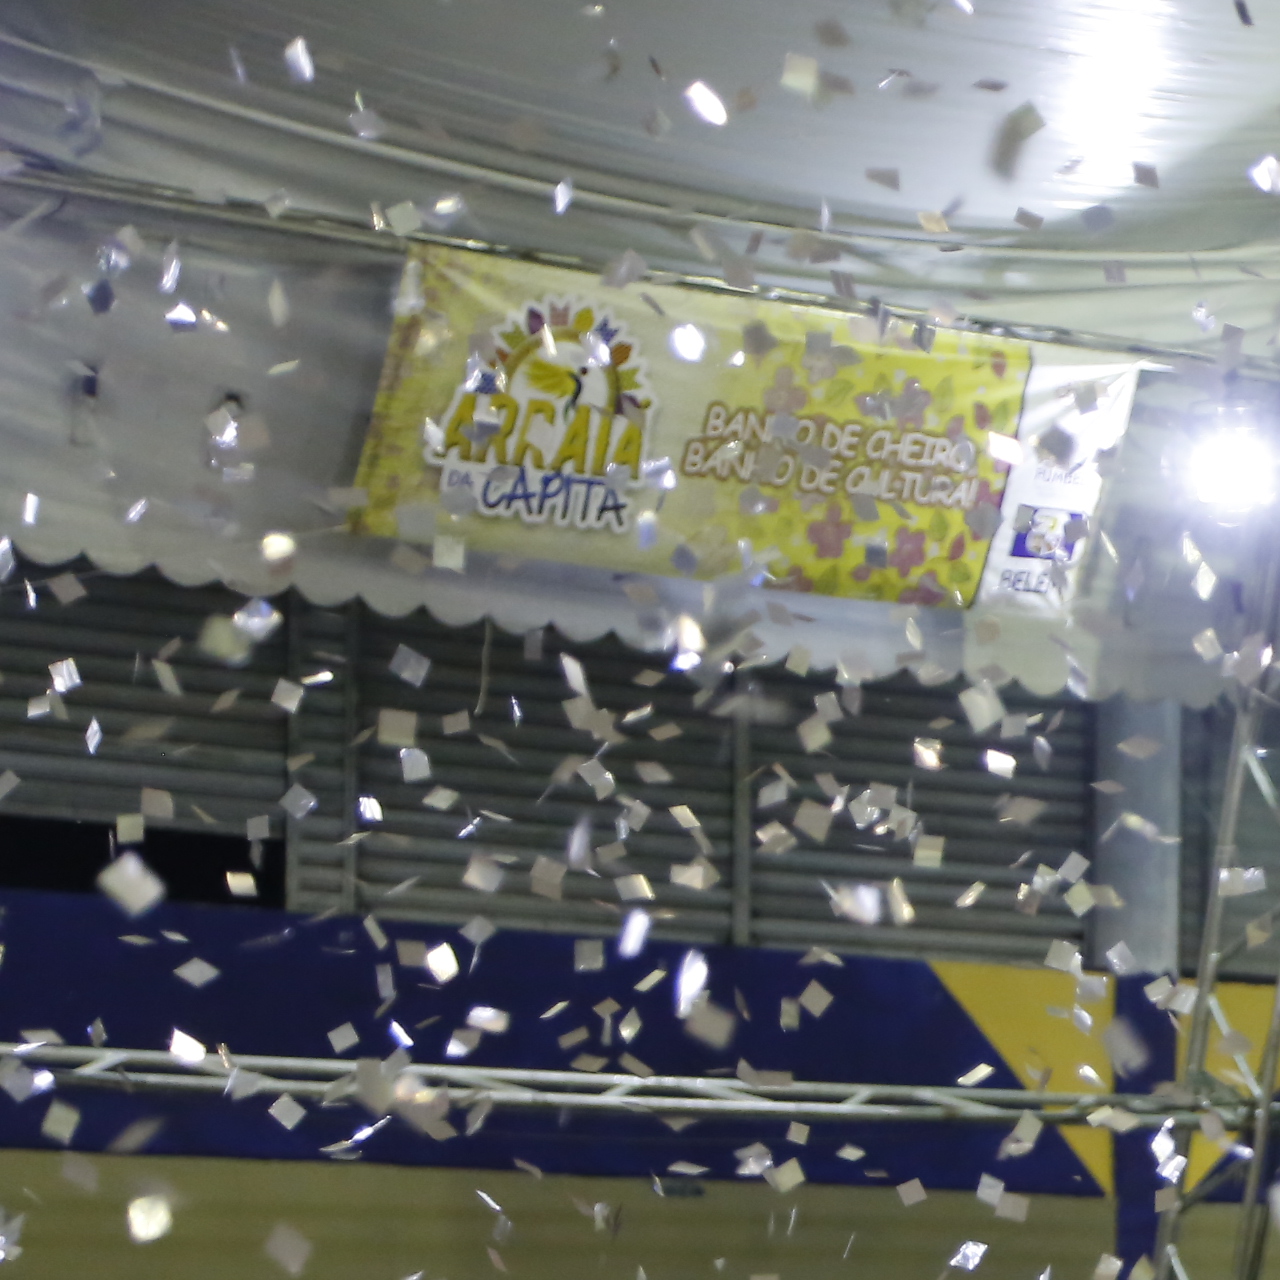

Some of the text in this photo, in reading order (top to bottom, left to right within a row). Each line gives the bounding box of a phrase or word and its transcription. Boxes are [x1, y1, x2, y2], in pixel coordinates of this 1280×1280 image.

[705, 404, 976, 473] BANO DE CHEIRO
[448, 469, 473, 488] DA
[683, 440, 795, 486] BANO
